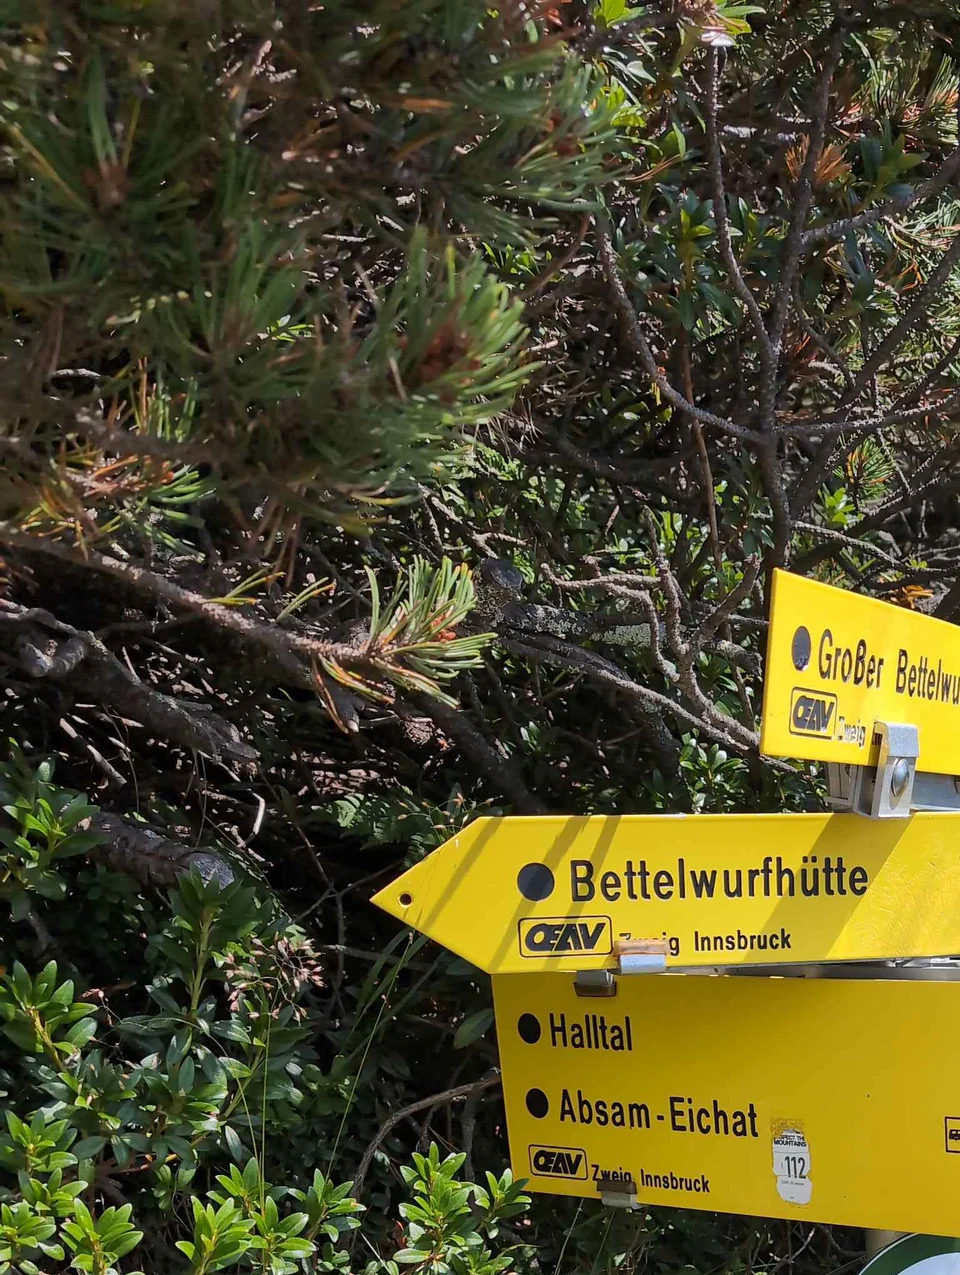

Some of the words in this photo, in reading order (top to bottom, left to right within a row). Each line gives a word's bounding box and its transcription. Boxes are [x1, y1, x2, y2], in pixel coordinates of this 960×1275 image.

[818, 628, 884, 689] Großer
[570, 855, 868, 902] Bettelwurfhütte
[694, 928, 792, 952] Innsbruck
[549, 1012, 633, 1051] Halltal
[559, 1088, 759, 1138] Absam-Eichat
[640, 1168, 711, 1193] Innsbruck
[785, 1155, 806, 1179] 112
